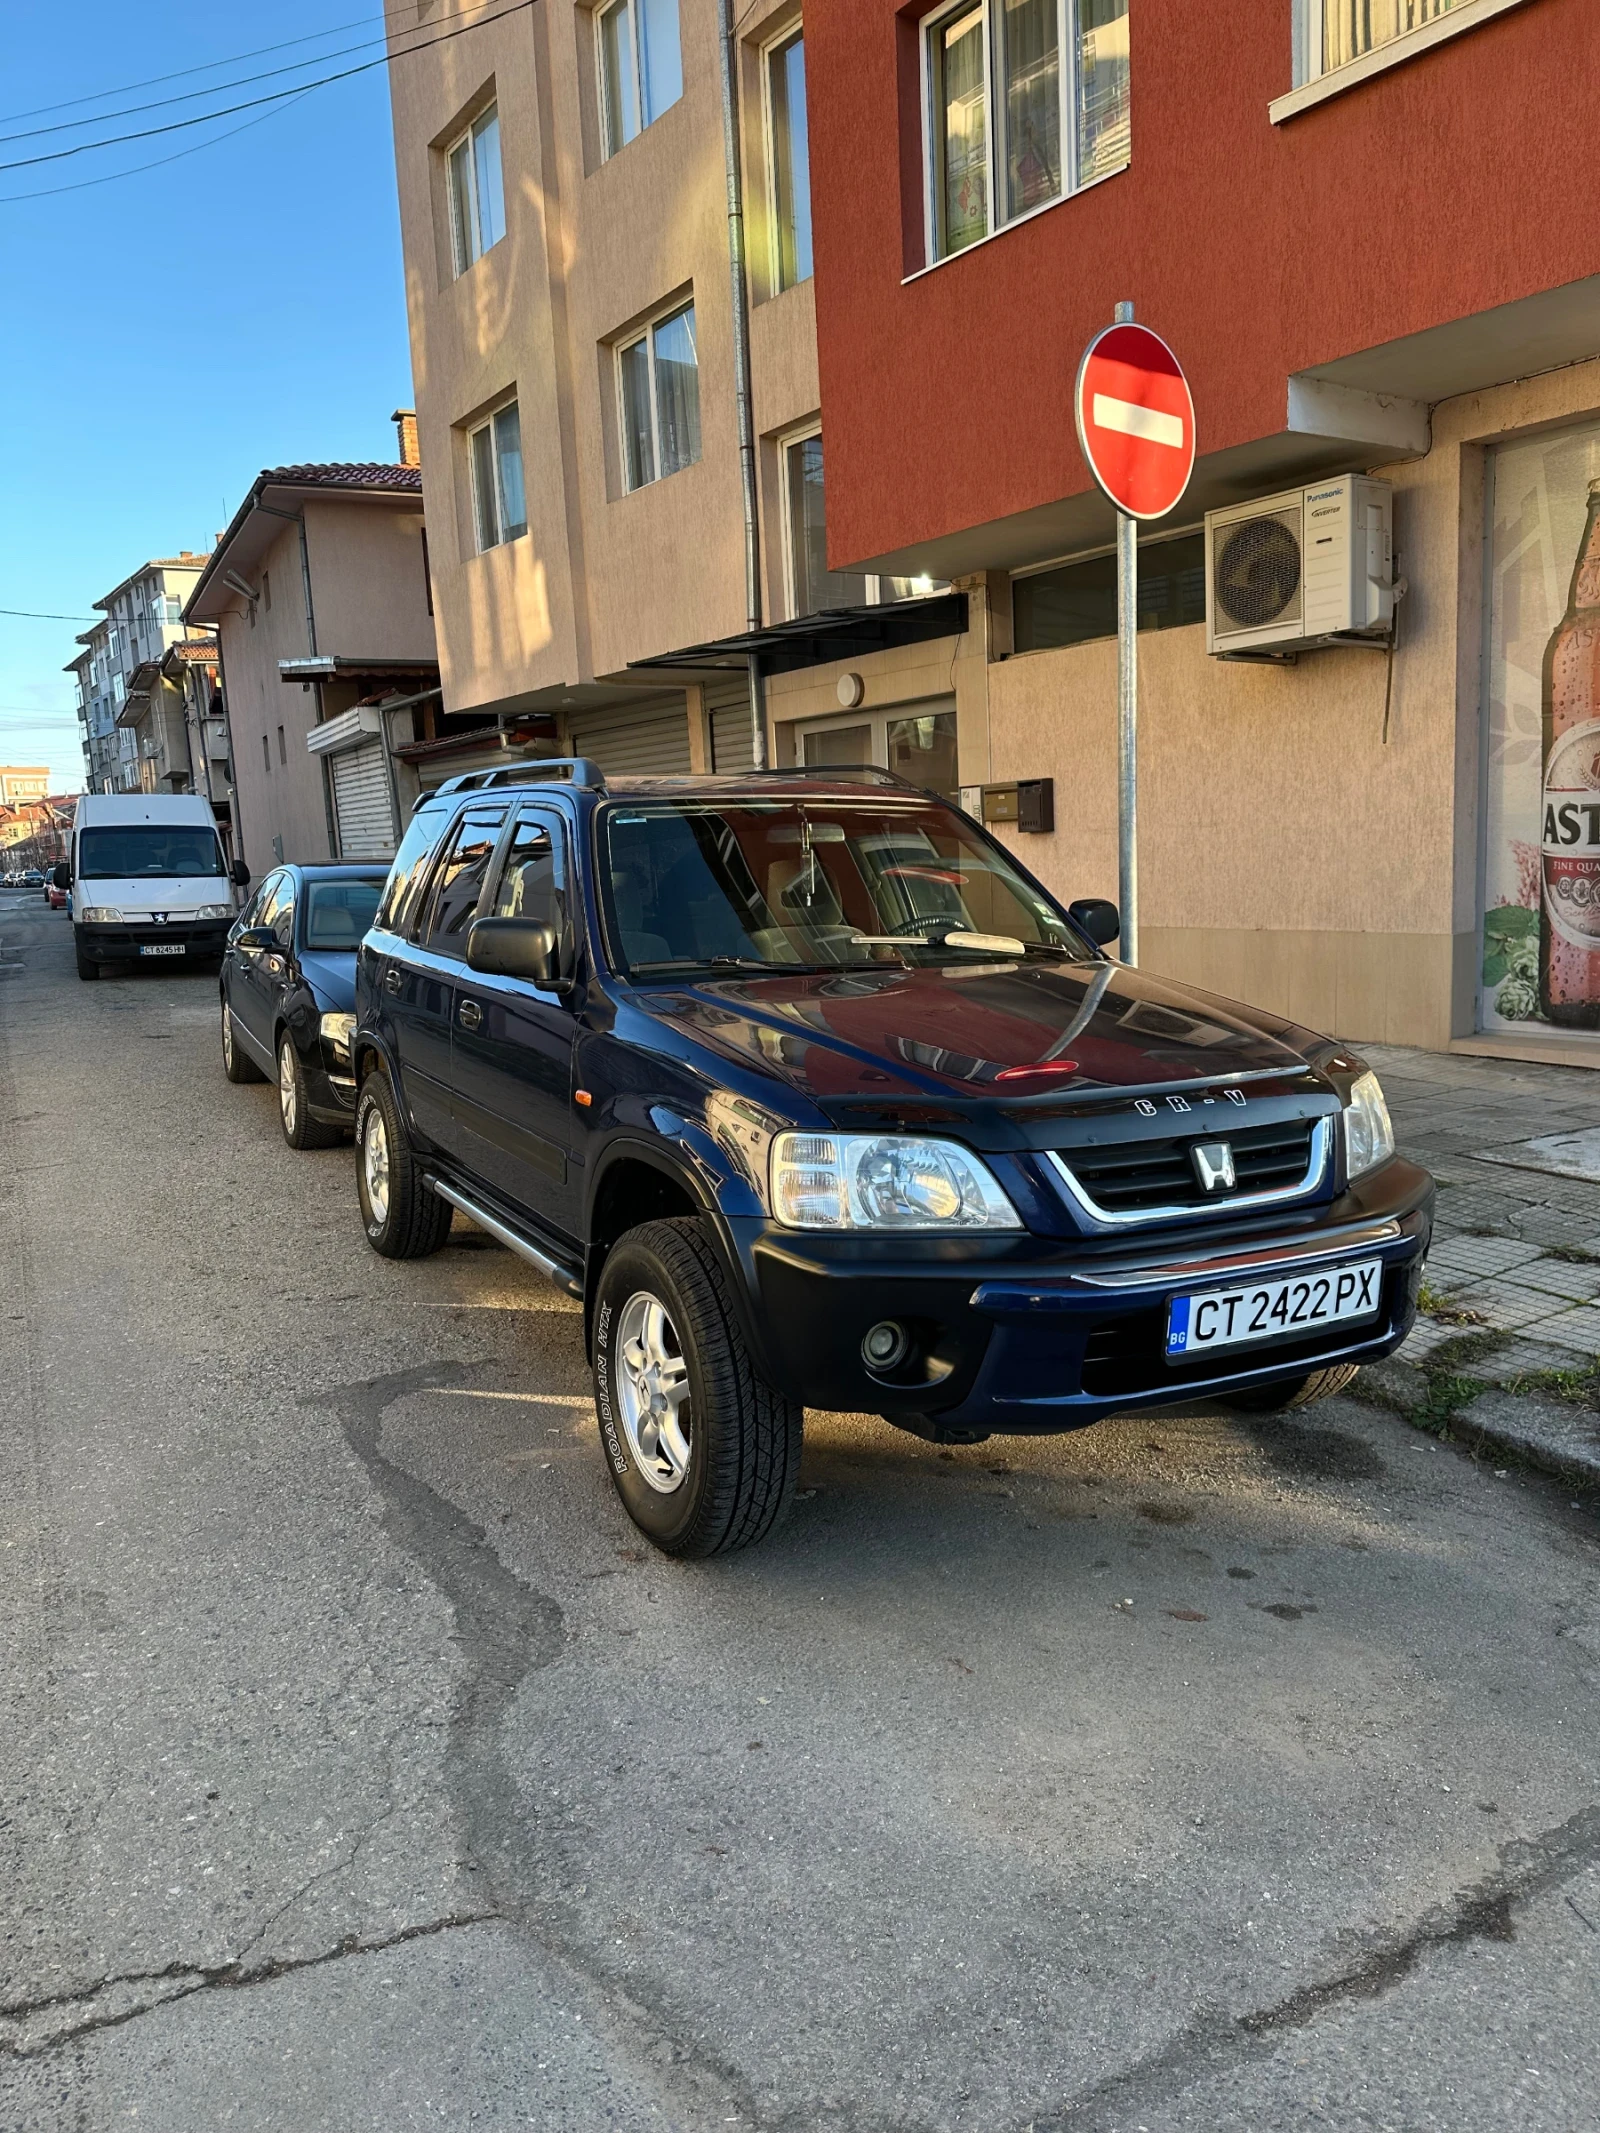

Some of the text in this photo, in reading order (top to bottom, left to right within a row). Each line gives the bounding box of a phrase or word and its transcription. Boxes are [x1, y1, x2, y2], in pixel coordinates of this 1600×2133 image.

[1307, 488, 1344, 502] Panasonic
[1312, 506, 1341, 517] INVERTER
[1553, 861, 1574, 871] FINE
[145, 946, 154, 954] CT
[1195, 1267, 1376, 1341] CT 2422 PX
[1170, 1331, 1186, 1345] BG
[597, 1354, 628, 1473] ROADIAN
